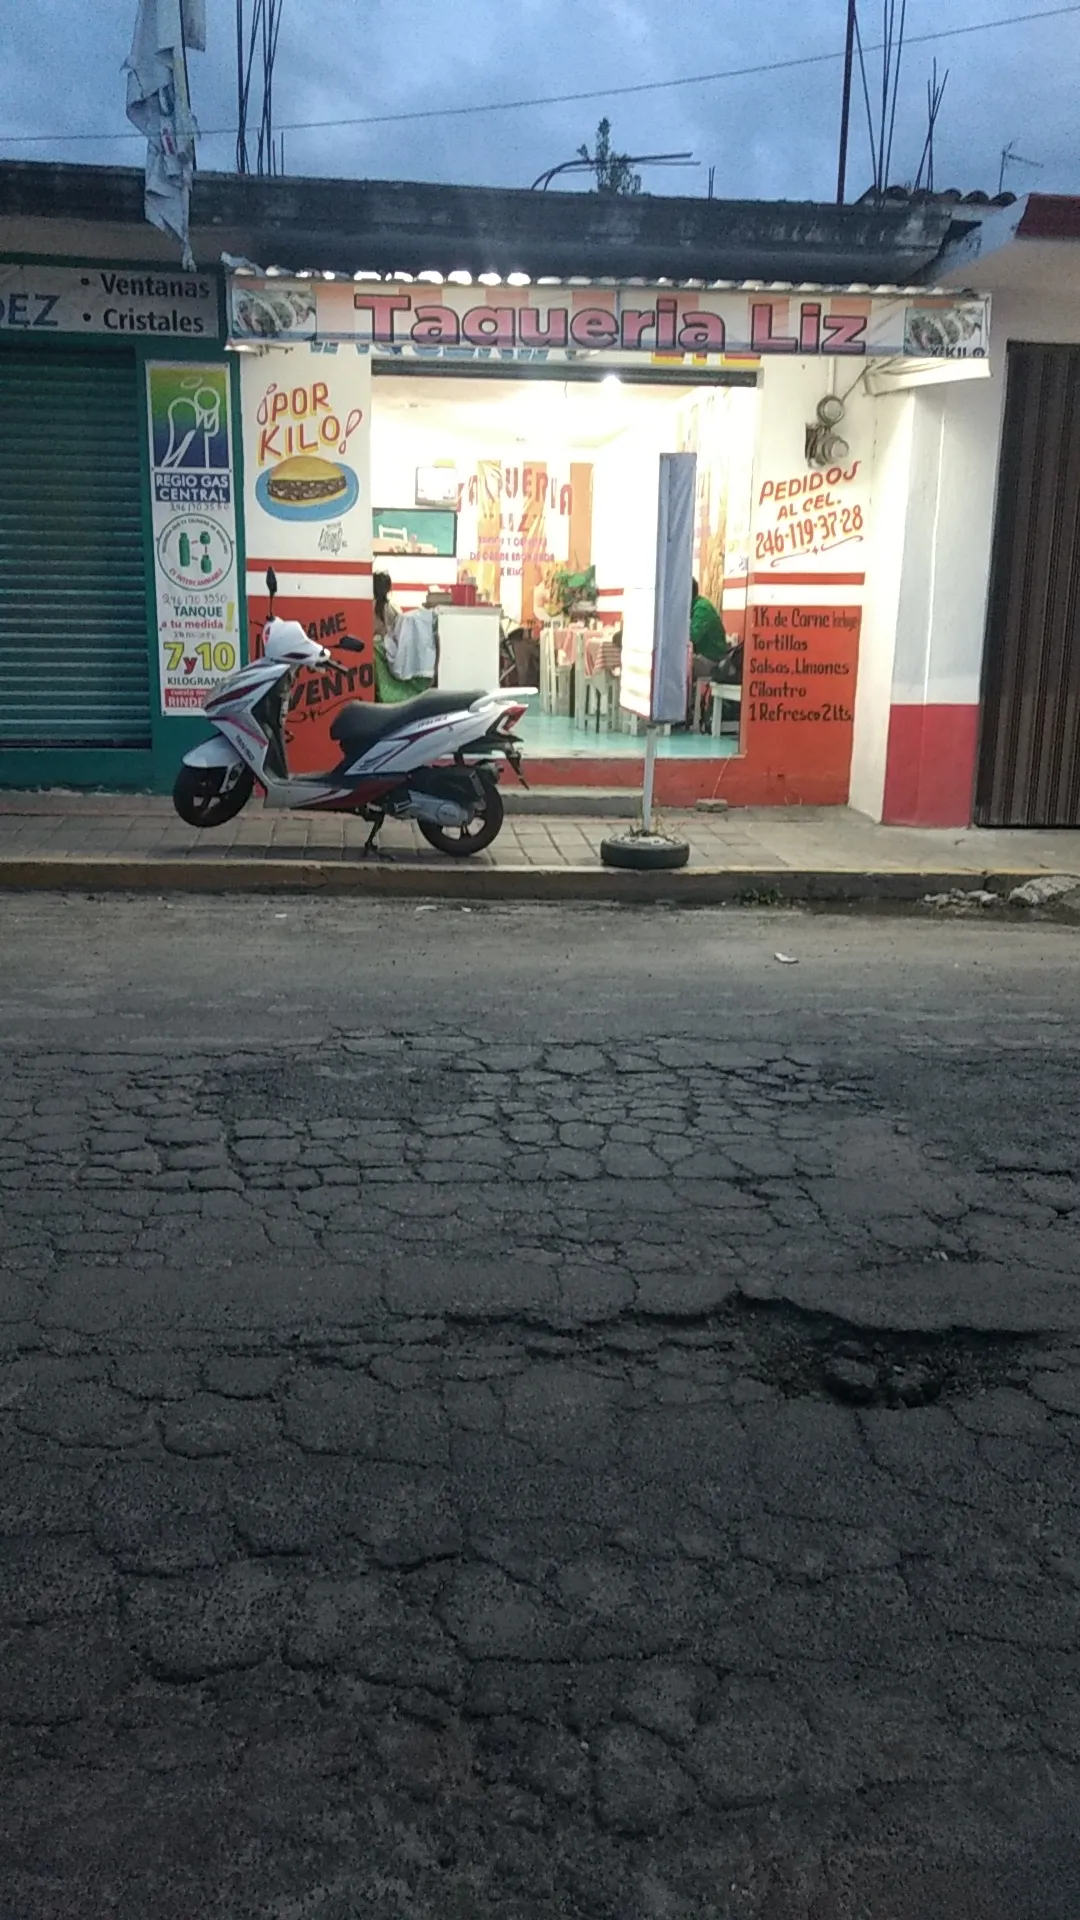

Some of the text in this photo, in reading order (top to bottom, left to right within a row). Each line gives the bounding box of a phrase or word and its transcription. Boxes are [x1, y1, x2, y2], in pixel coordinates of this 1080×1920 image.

[101, 273, 210, 299] Ventanas
[0, 293, 60, 327] EZ
[103, 308, 204, 333] Cristales
[354, 293, 868, 354] Taqueria Liz
[156, 474, 229, 488] REGIO GAS
[758, 460, 861, 506] PEDIDOS
[159, 487, 227, 501] CENTRAL
[777, 503, 798, 521] AL
[173, 605, 223, 619] TANQUE
[774, 610, 788, 627] de
[791, 608, 830, 628] Carne
[161, 620, 224, 629] a tu medida
[752, 633, 808, 651] Tortillas
[795, 657, 850, 675] Limones
[749, 681, 807, 698] Cilantro
[759, 703, 821, 721] Refresco
